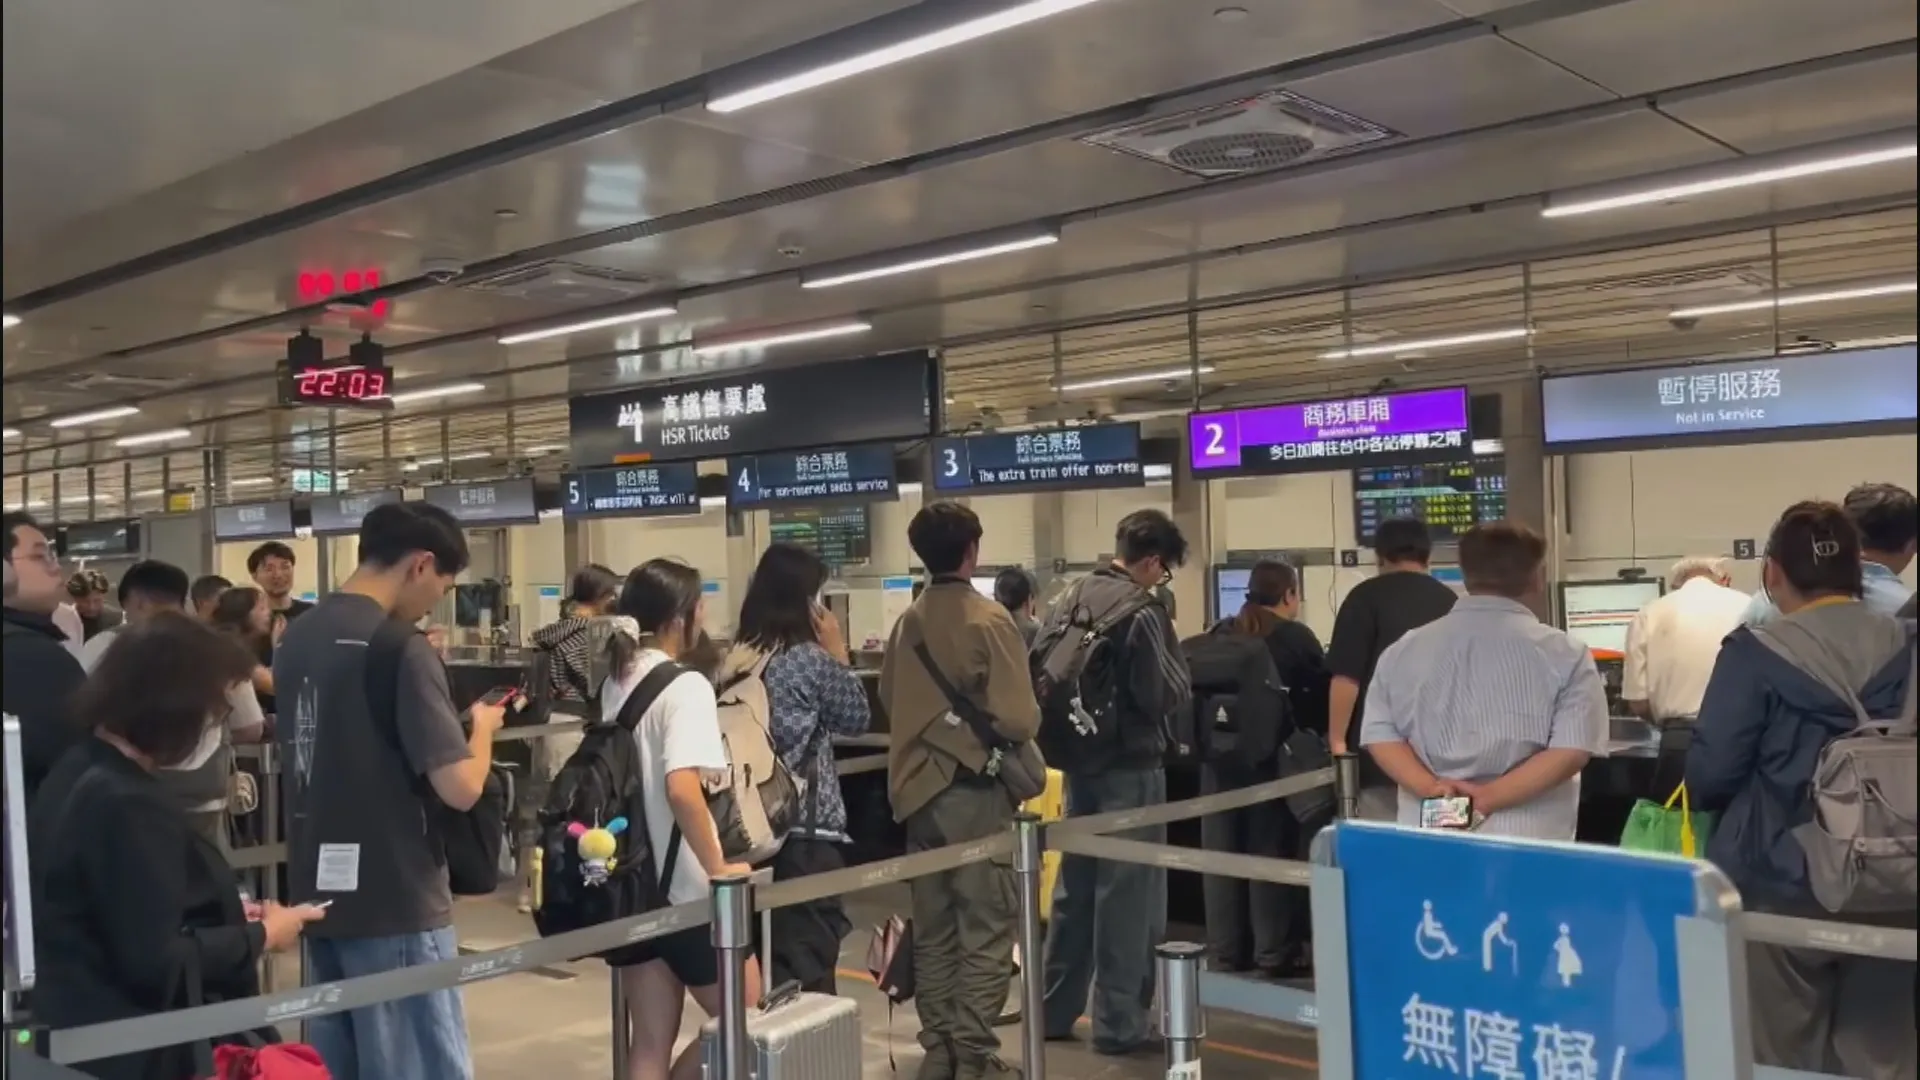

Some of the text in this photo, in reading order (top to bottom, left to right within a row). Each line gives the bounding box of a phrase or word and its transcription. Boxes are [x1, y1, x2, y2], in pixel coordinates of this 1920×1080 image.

[300, 370, 384, 399] 22:03
[1658, 369, 1781, 406] 暫停服務
[661, 383, 767, 424] 高鐵售票處
[1303, 397, 1390, 428] 商務車廂
[1676, 408, 1765, 425] Not in Service
[661, 424, 731, 446] HSR Tickets
[1204, 422, 1226, 456] 2
[943, 448, 960, 477] 3
[978, 468, 995, 483] The
[998, 465, 1026, 481] extra
[1029, 465, 1058, 480] train
[1061, 462, 1090, 479] offer
[568, 480, 580, 504] 5
[737, 467, 751, 493] 4
[856, 479, 889, 492] service
[1345, 553, 1354, 565] 6
[1739, 543, 1750, 556] 5
